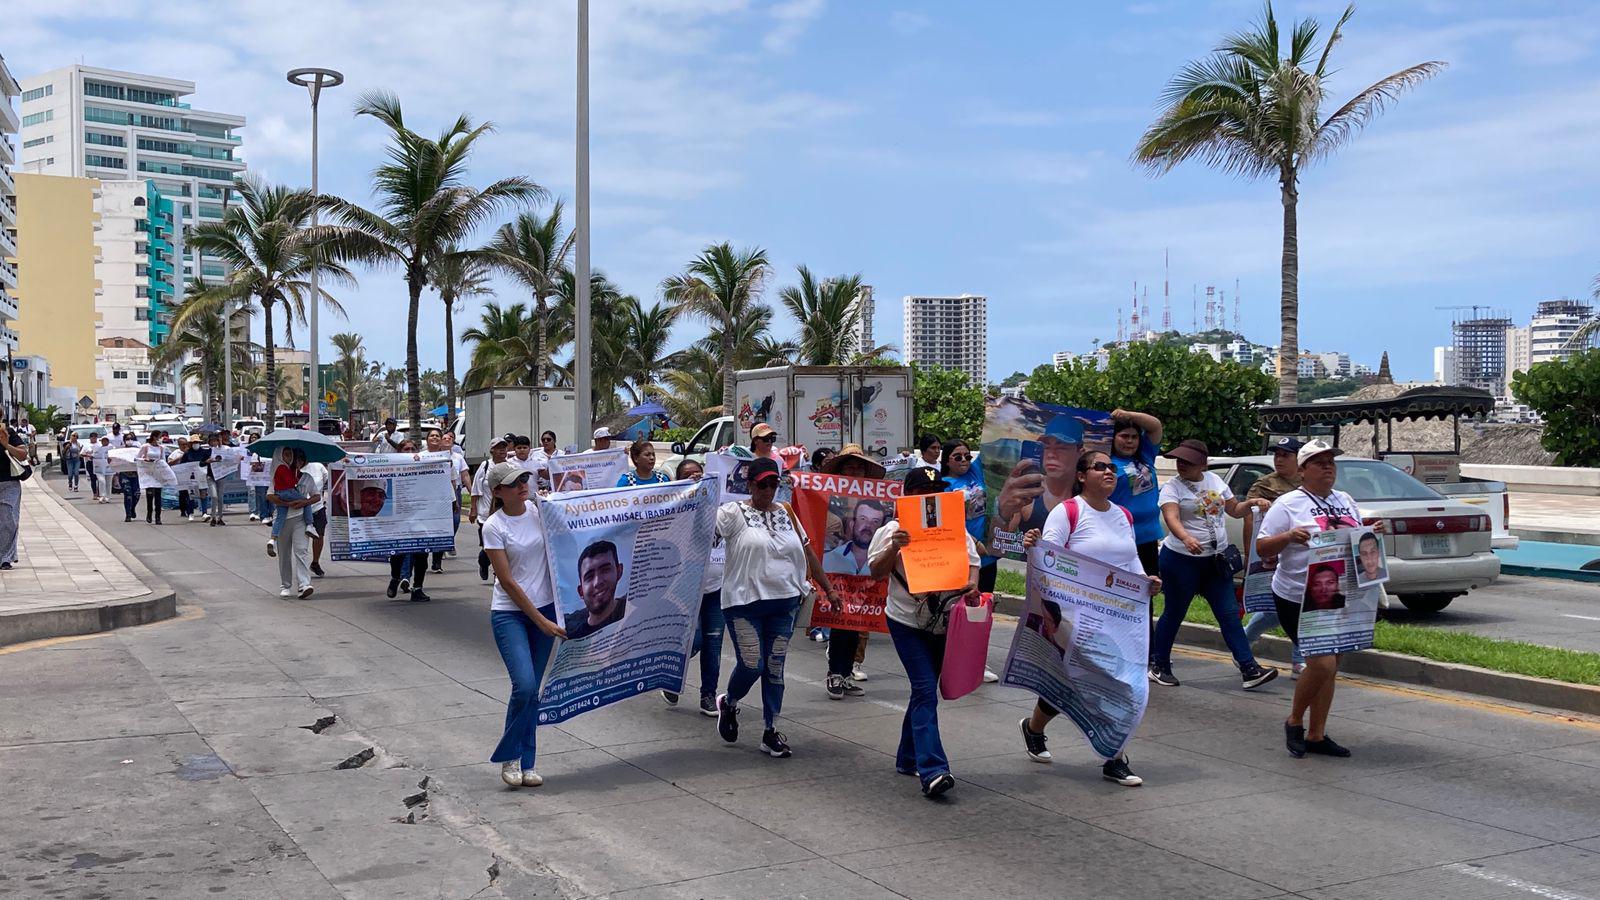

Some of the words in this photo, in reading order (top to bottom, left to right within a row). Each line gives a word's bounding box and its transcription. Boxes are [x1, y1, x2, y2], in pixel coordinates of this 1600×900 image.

[565, 498, 628, 517] Ayúdanos
[632, 496, 640, 505] a
[643, 488, 698, 505] encontrar
[701, 487, 708, 496] a
[645, 507, 676, 519] IBARRA
[1056, 562, 1079, 577] Sinaloa
[1048, 590, 1076, 605] MANUEL
[1076, 597, 1105, 614] MARTÍNEZ
[1105, 608, 1142, 624] CERVANTES
[1088, 592, 1129, 610] encontrar
[653, 654, 681, 664] persona
